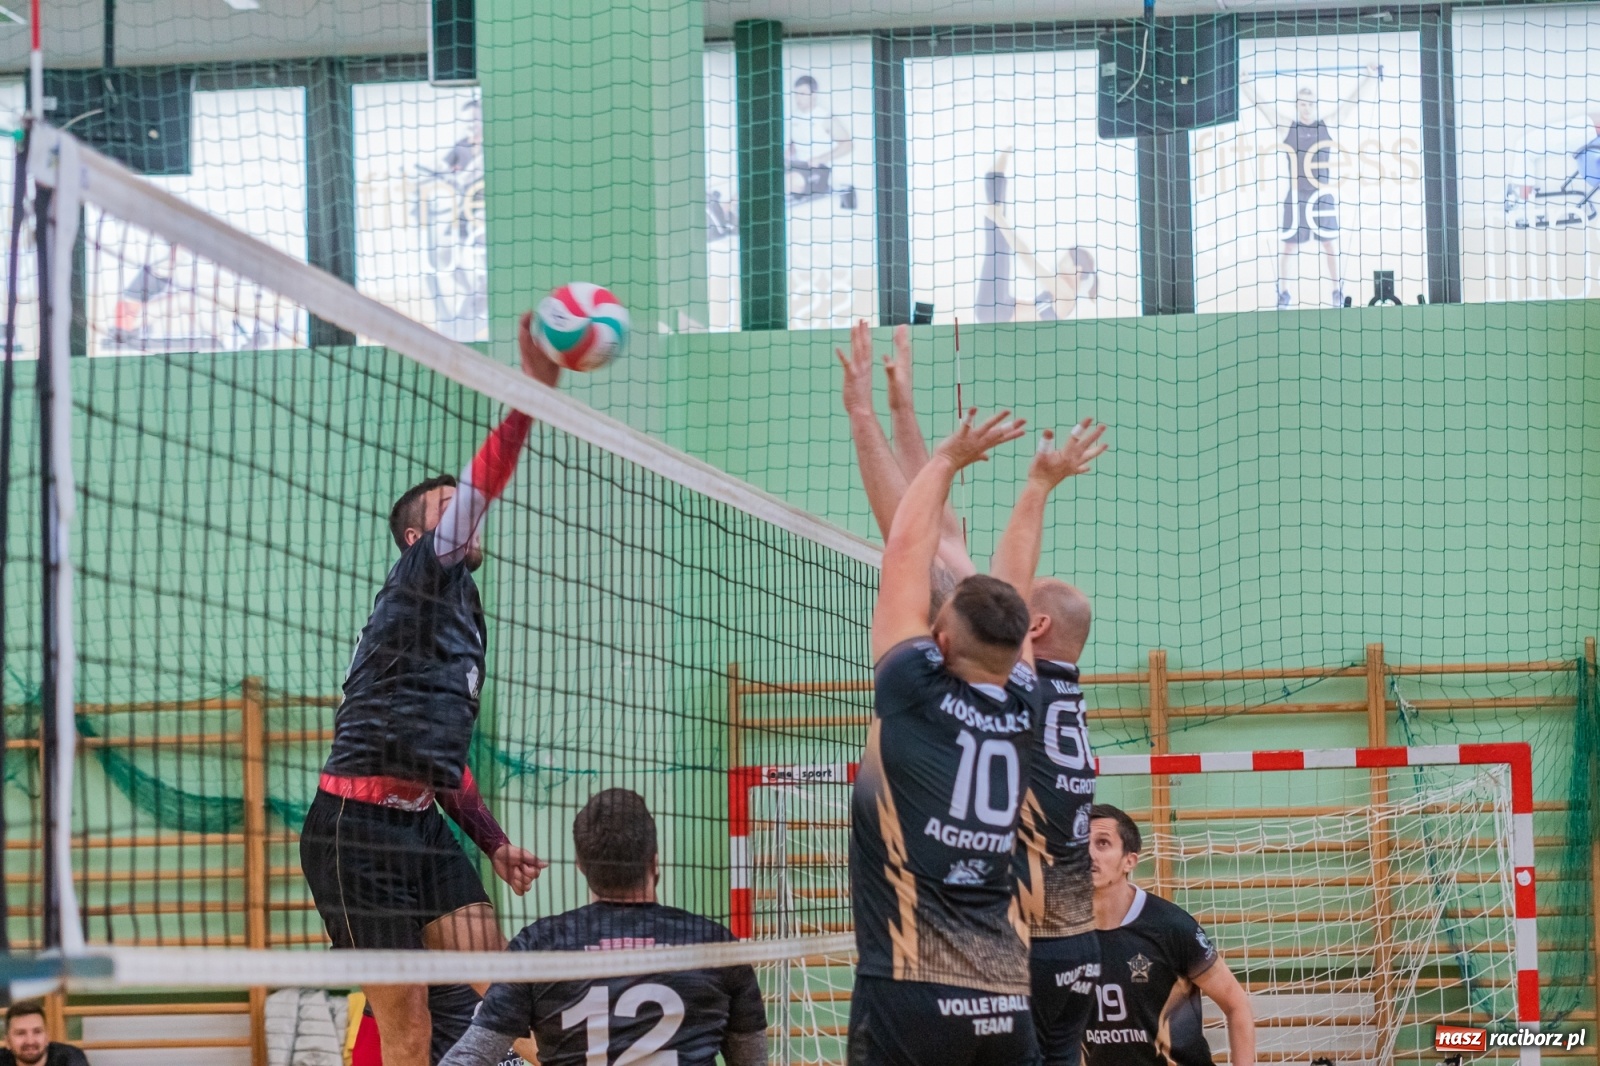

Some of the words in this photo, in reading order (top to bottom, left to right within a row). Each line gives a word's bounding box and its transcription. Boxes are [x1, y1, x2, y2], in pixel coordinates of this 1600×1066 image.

[1195, 131, 1420, 196] fitness
[801, 769, 832, 780] sport
[950, 730, 1020, 827] 10
[937, 995, 1029, 1016] VOLLEYBALL
[1095, 983, 1128, 1022] 19
[561, 983, 685, 1066] 12
[972, 1017, 1014, 1036] TEAM
[1085, 1028, 1149, 1044] AGROTIM
